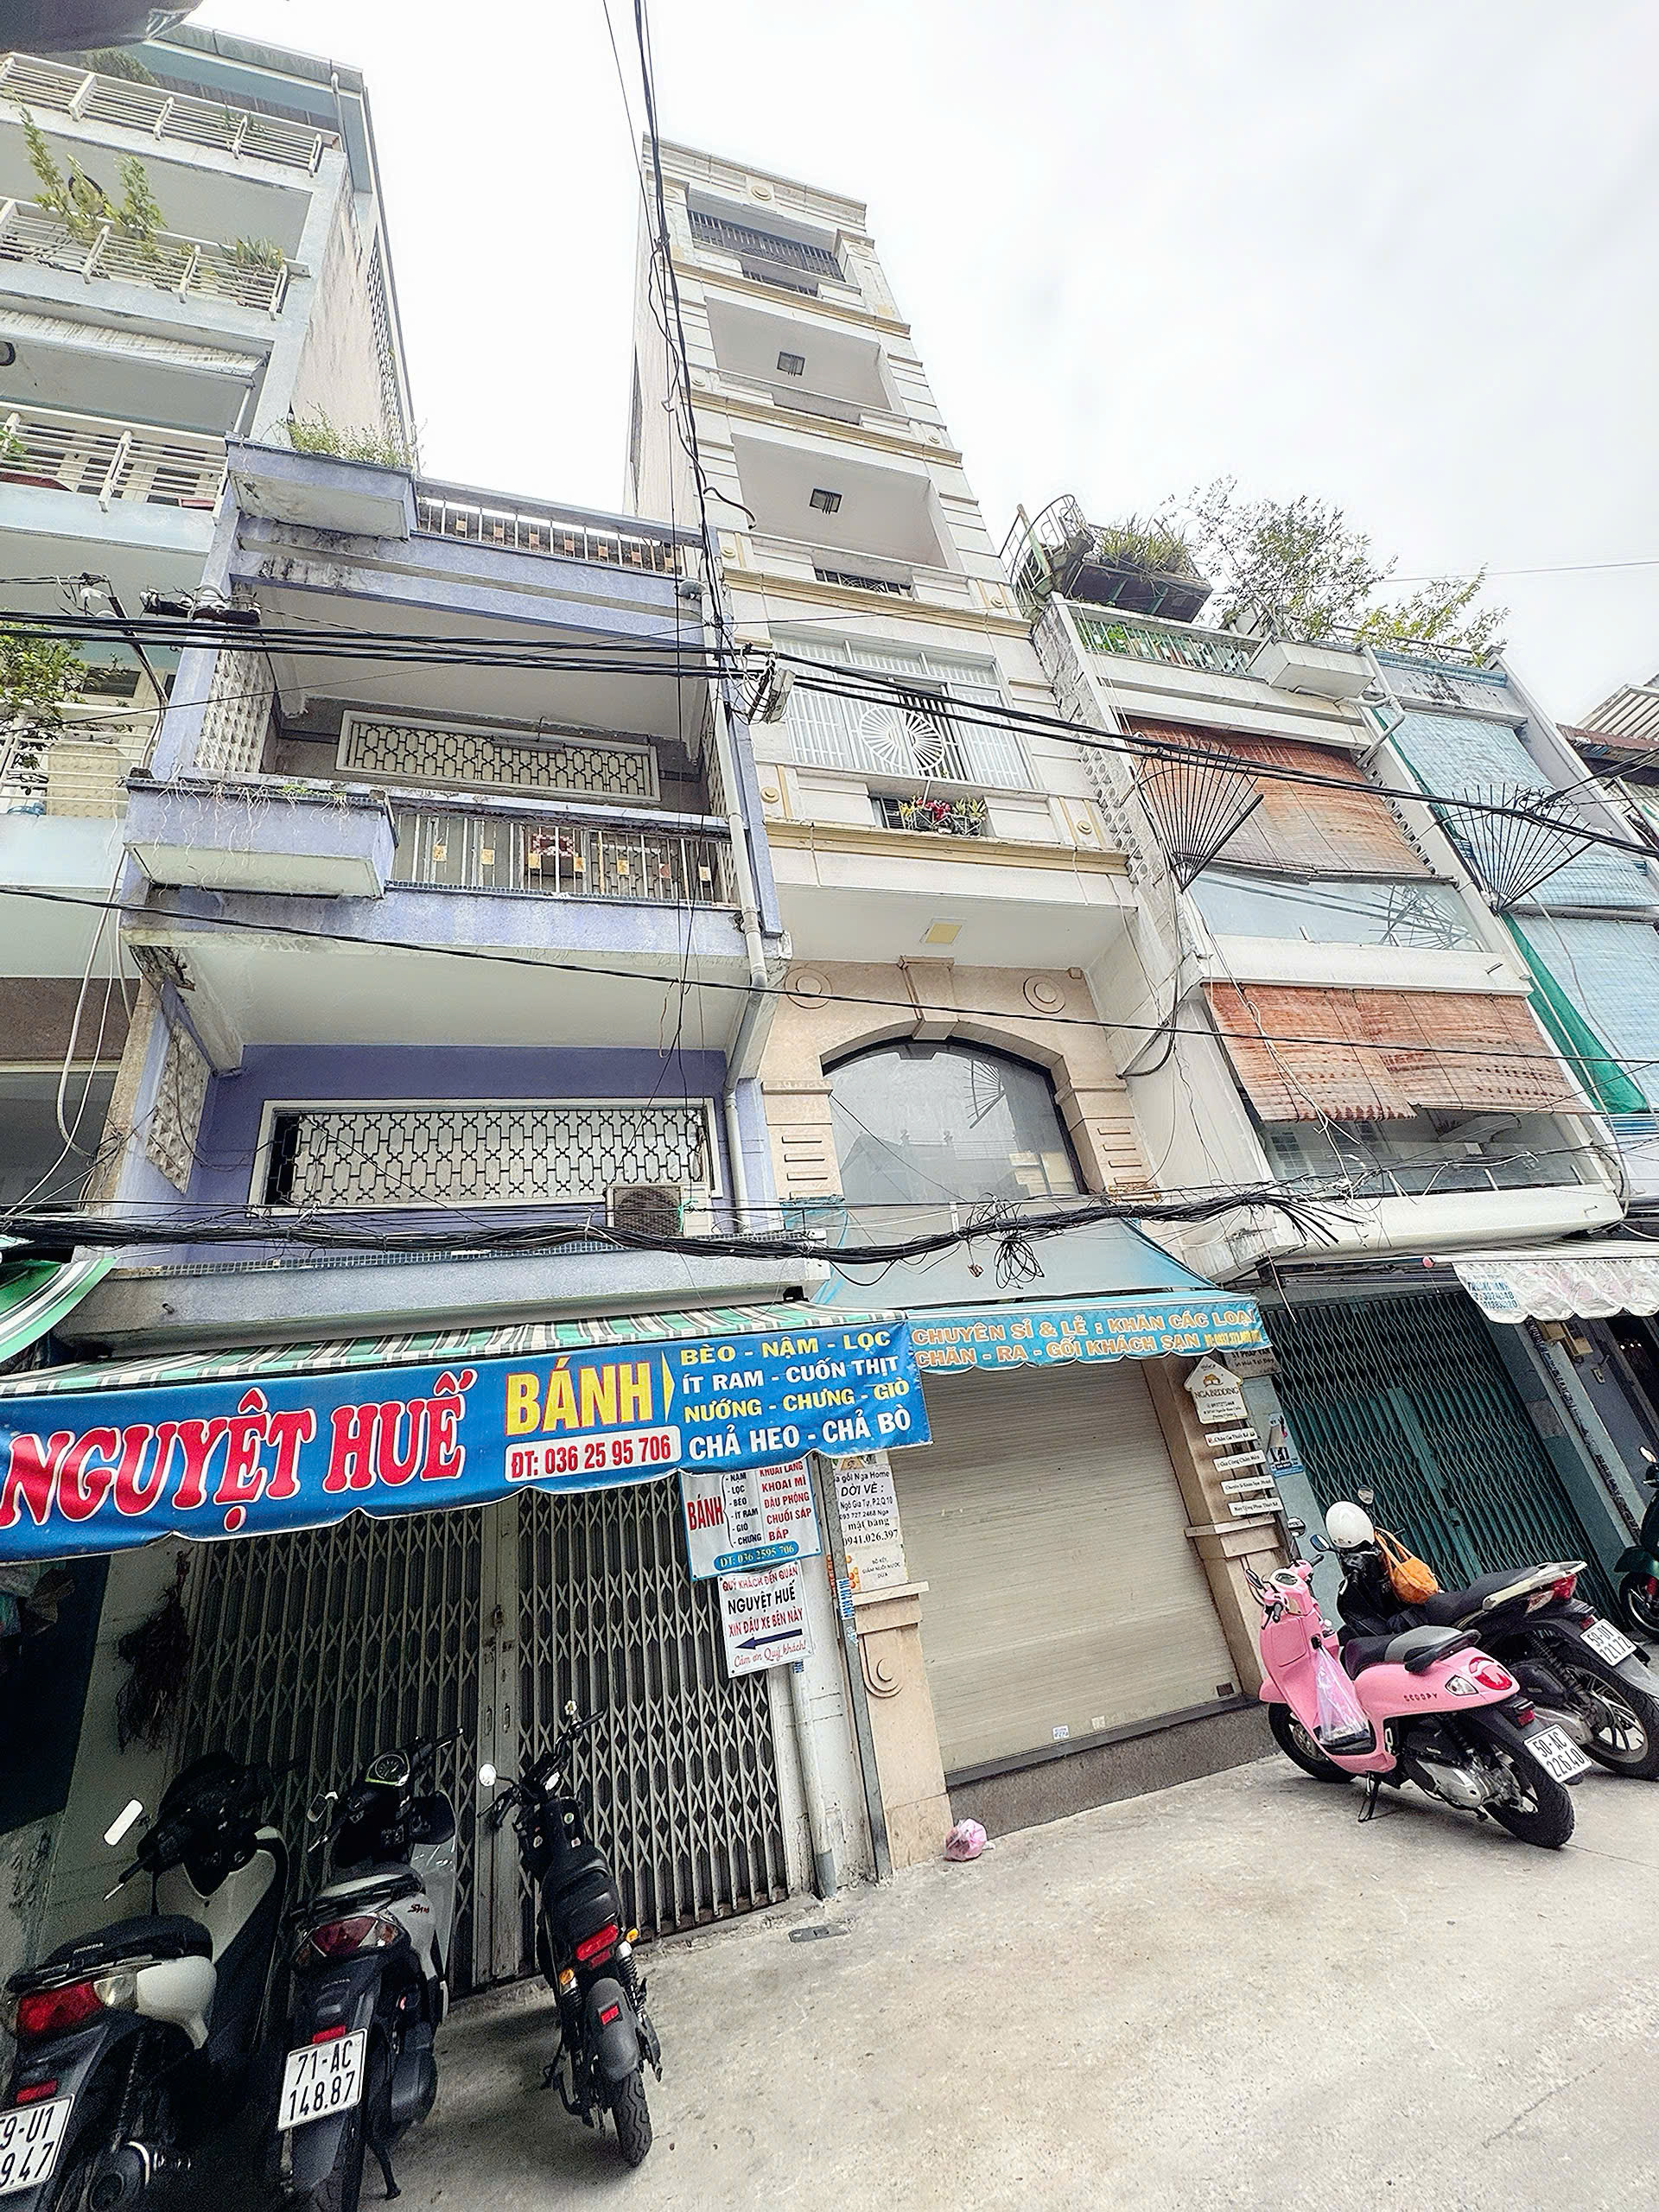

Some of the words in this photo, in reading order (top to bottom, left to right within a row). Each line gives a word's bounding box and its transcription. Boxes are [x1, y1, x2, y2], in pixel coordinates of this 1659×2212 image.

[912, 1322, 1006, 1345] CHUYÊN
[1011, 1319, 1033, 1338] SỈ
[1039, 1322, 1058, 1337] &
[1060, 1315, 1088, 1336] LẺ
[1106, 1315, 1166, 1333] KHĂN
[1168, 1310, 1209, 1330] CÁC
[1211, 1308, 1256, 1327] LOẠI
[680, 1344, 736, 1366] BÈO
[761, 1336, 819, 1359] NẬM
[842, 1331, 892, 1351] LỌC
[914, 1345, 976, 1367] CHĂN
[996, 1344, 1028, 1363] RA
[1046, 1337, 1082, 1358] GỐI
[1086, 1334, 1158, 1357] KHÁCH
[1160, 1333, 1200, 1351] SẠN
[682, 1372, 704, 1395] ÍT
[712, 1370, 764, 1391] RAM
[785, 1357, 847, 1382] CUỐN
[851, 1356, 899, 1377] THỊT
[505, 1356, 653, 1436] BÁNH
[683, 1398, 762, 1424] NƯỚNG
[782, 1388, 854, 1412] CHƯNG
[874, 1376, 910, 1401] GIÒ
[689, 1424, 741, 1461] CHẢ
[750, 1425, 800, 1453] HEO
[823, 1408, 871, 1443] CHẢ
[877, 1404, 911, 1435] BÒ
[0, 1387, 316, 1532] NGUYỆT
[322, 1369, 478, 1493] HUẾ
[512, 1451, 538, 1478] ĐT:
[544, 1446, 578, 1474] 036
[584, 1442, 606, 1469] 25
[612, 1440, 632, 1465] 95
[639, 1434, 671, 1461] 706
[732, 1485, 745, 1495] LỌC
[762, 1481, 791, 1492] KHOAI
[795, 1476, 806, 1486] MÌ
[842, 1484, 861, 1497] DỜI
[869, 1471, 890, 1479] Home
[686, 1493, 724, 1530] BÁNH
[743, 1508, 759, 1518] RAM
[766, 1508, 793, 1524] CHUỐI
[737, 1553, 753, 1563] 036
[756, 1548, 776, 1559] 2595
[779, 1544, 795, 1554] 706
[779, 1565, 798, 1580] QUÁN
[728, 1591, 771, 1615] NGUYỆT
[775, 1580, 795, 1605] HUẾ
[728, 1623, 741, 1637] XIN
[743, 1617, 759, 1636] ĐẬU
[760, 1617, 771, 1630] XE
[772, 1610, 786, 1627] BÊN
[788, 1605, 802, 1623] NÀY
[1547, 1747, 1585, 1778] 226.40
[296, 2040, 353, 2085] 71-AC
[290, 2070, 355, 2121] 148.87
[0, 2106, 54, 2150] 9-U1
